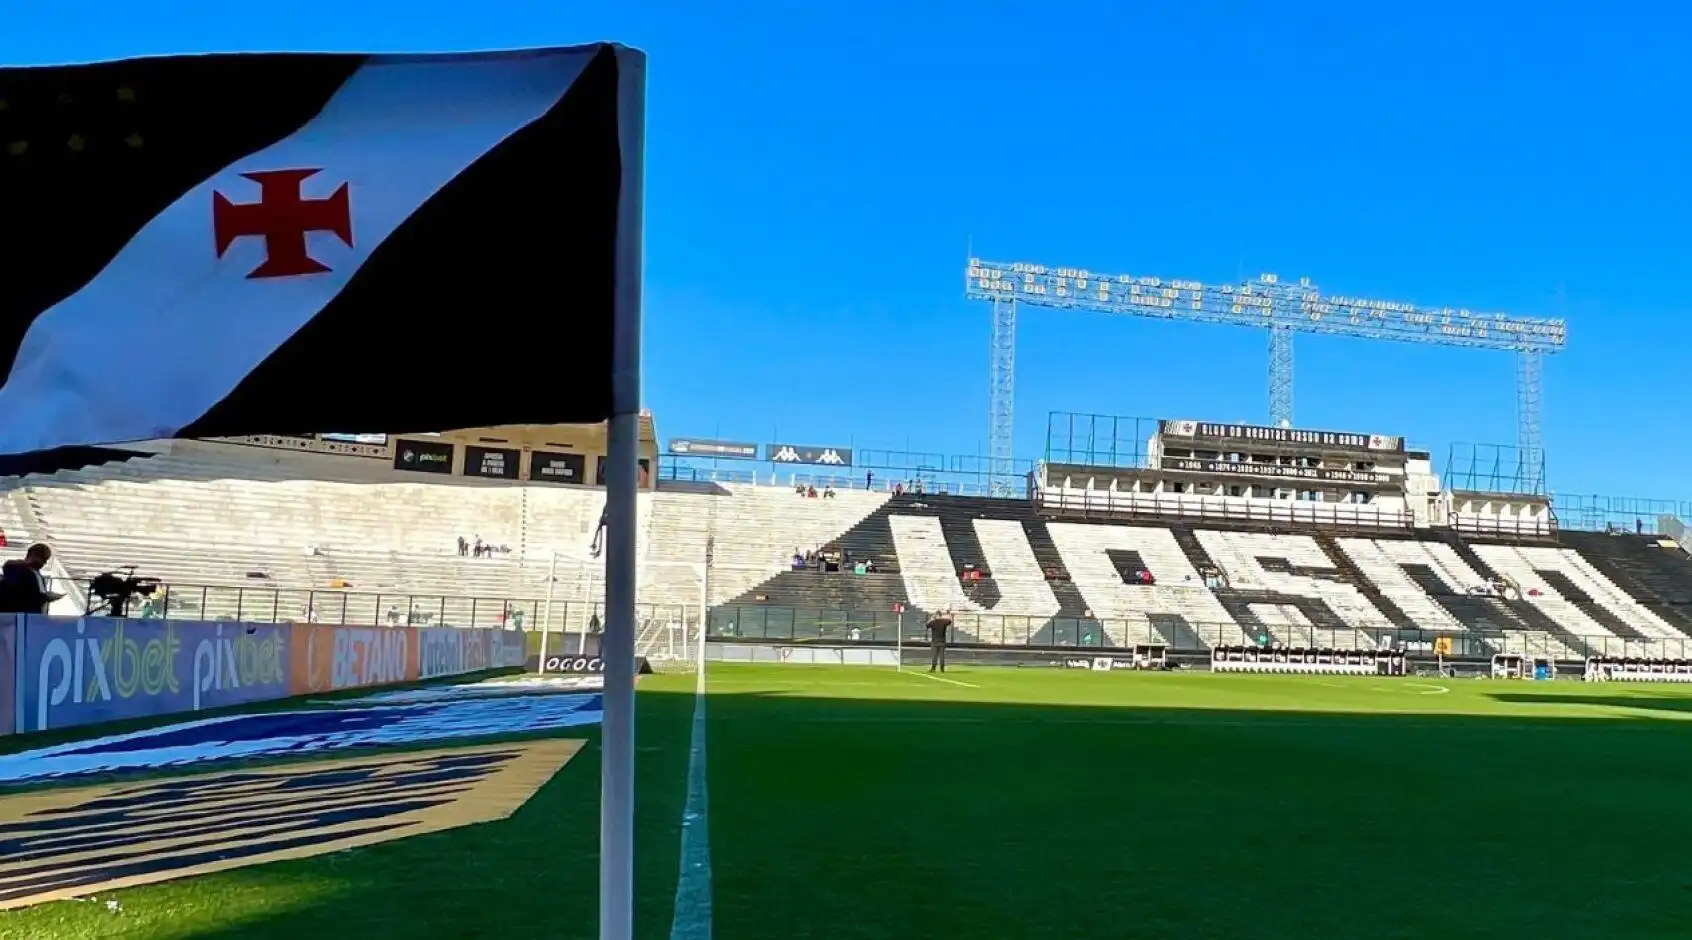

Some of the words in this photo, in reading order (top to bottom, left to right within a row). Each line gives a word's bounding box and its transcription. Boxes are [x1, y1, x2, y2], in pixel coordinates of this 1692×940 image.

[888, 514, 1691, 658] VASCO
[38, 619, 180, 731] pixbet
[193, 623, 284, 711] pixbet
[331, 627, 408, 687] BETANO
